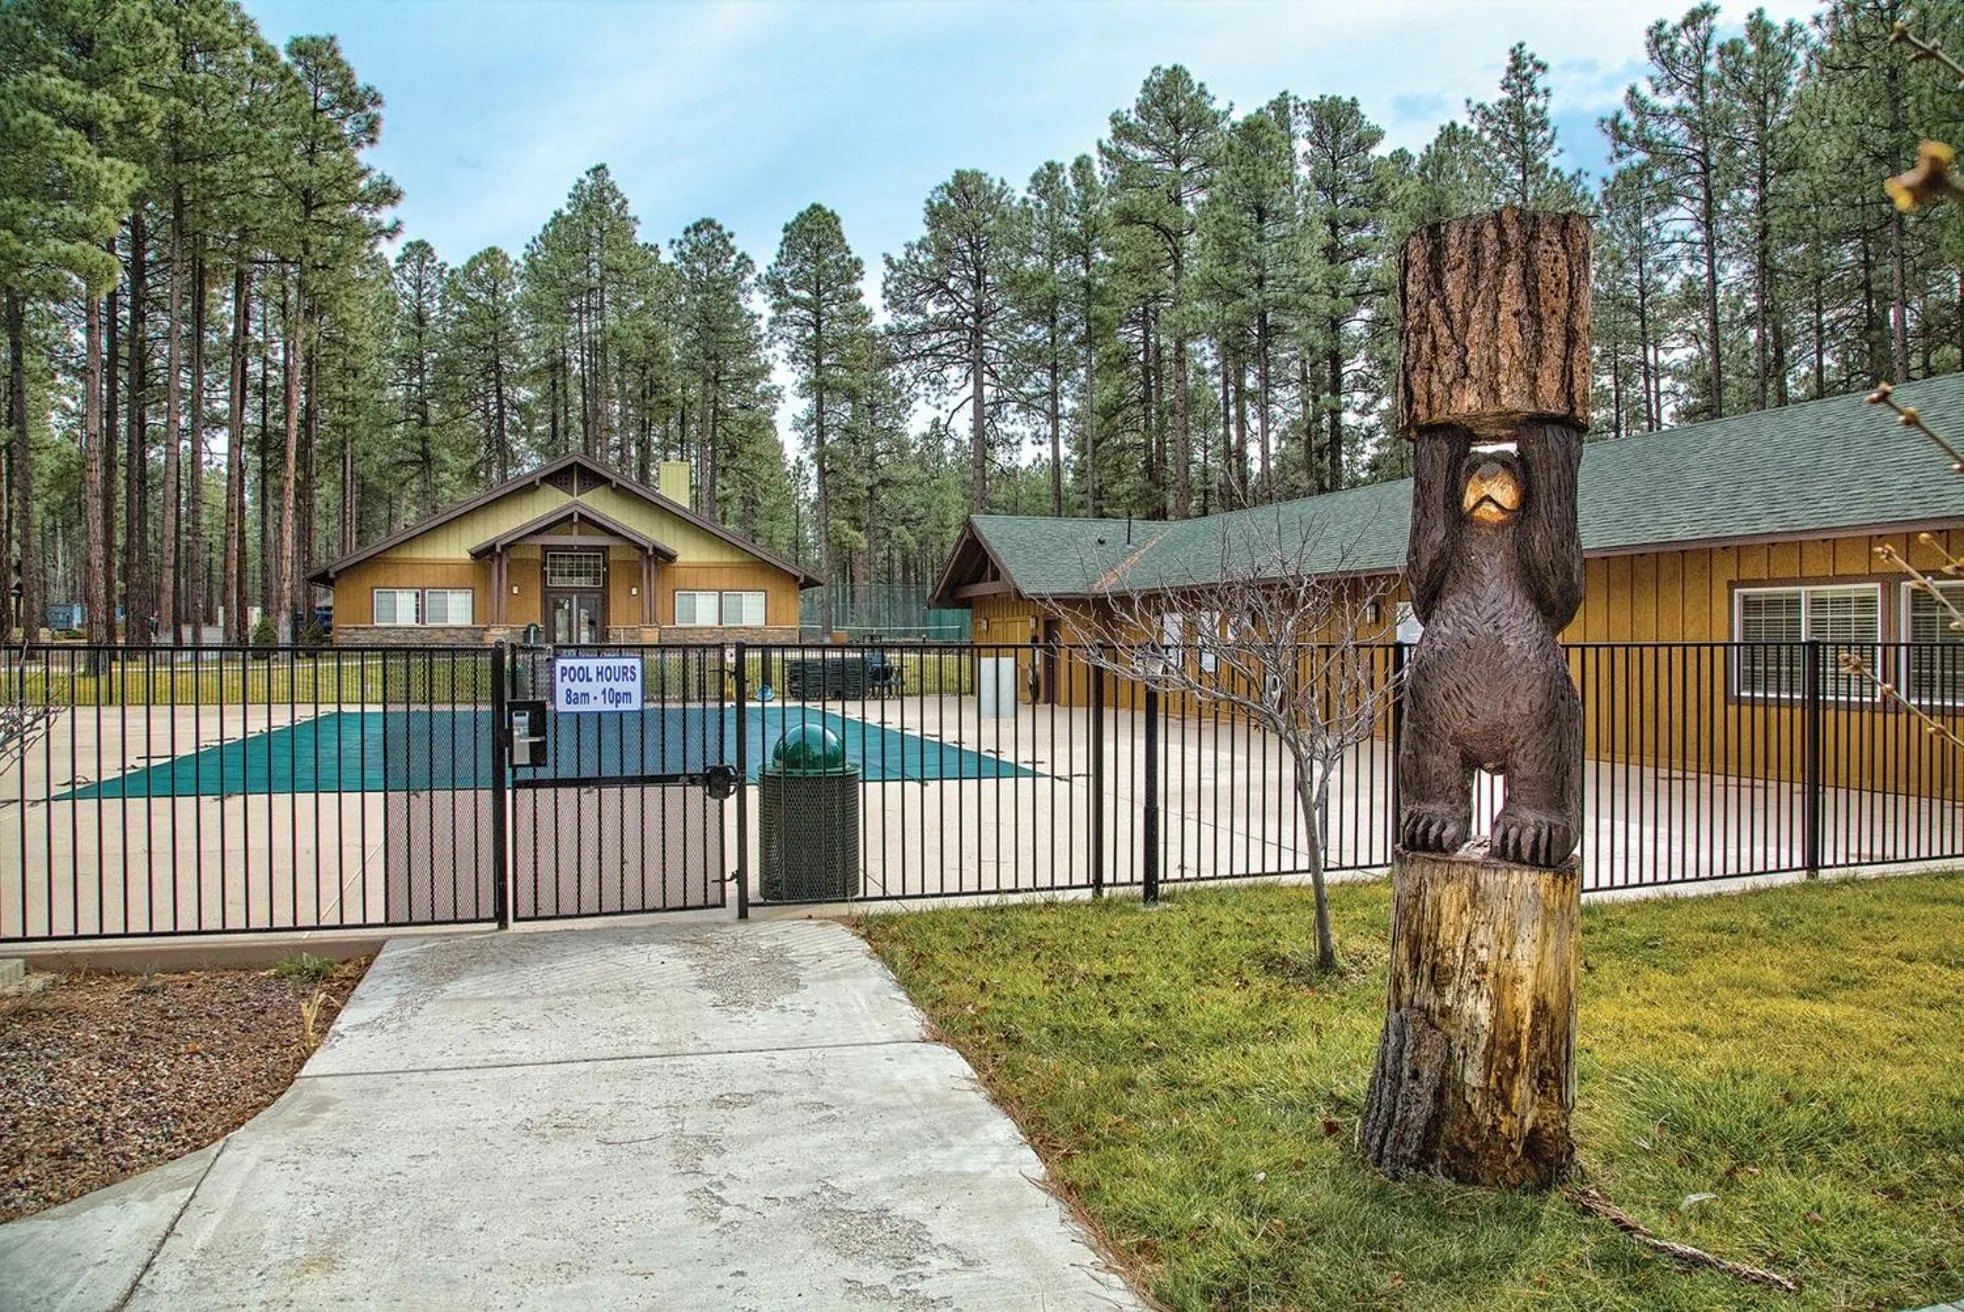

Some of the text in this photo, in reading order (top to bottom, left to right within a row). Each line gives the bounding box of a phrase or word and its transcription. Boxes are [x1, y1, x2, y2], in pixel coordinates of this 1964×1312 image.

[560, 665, 637, 683] POOL HOURS
[565, 688, 590, 705] 8am
[601, 687, 632, 708] 10pm
